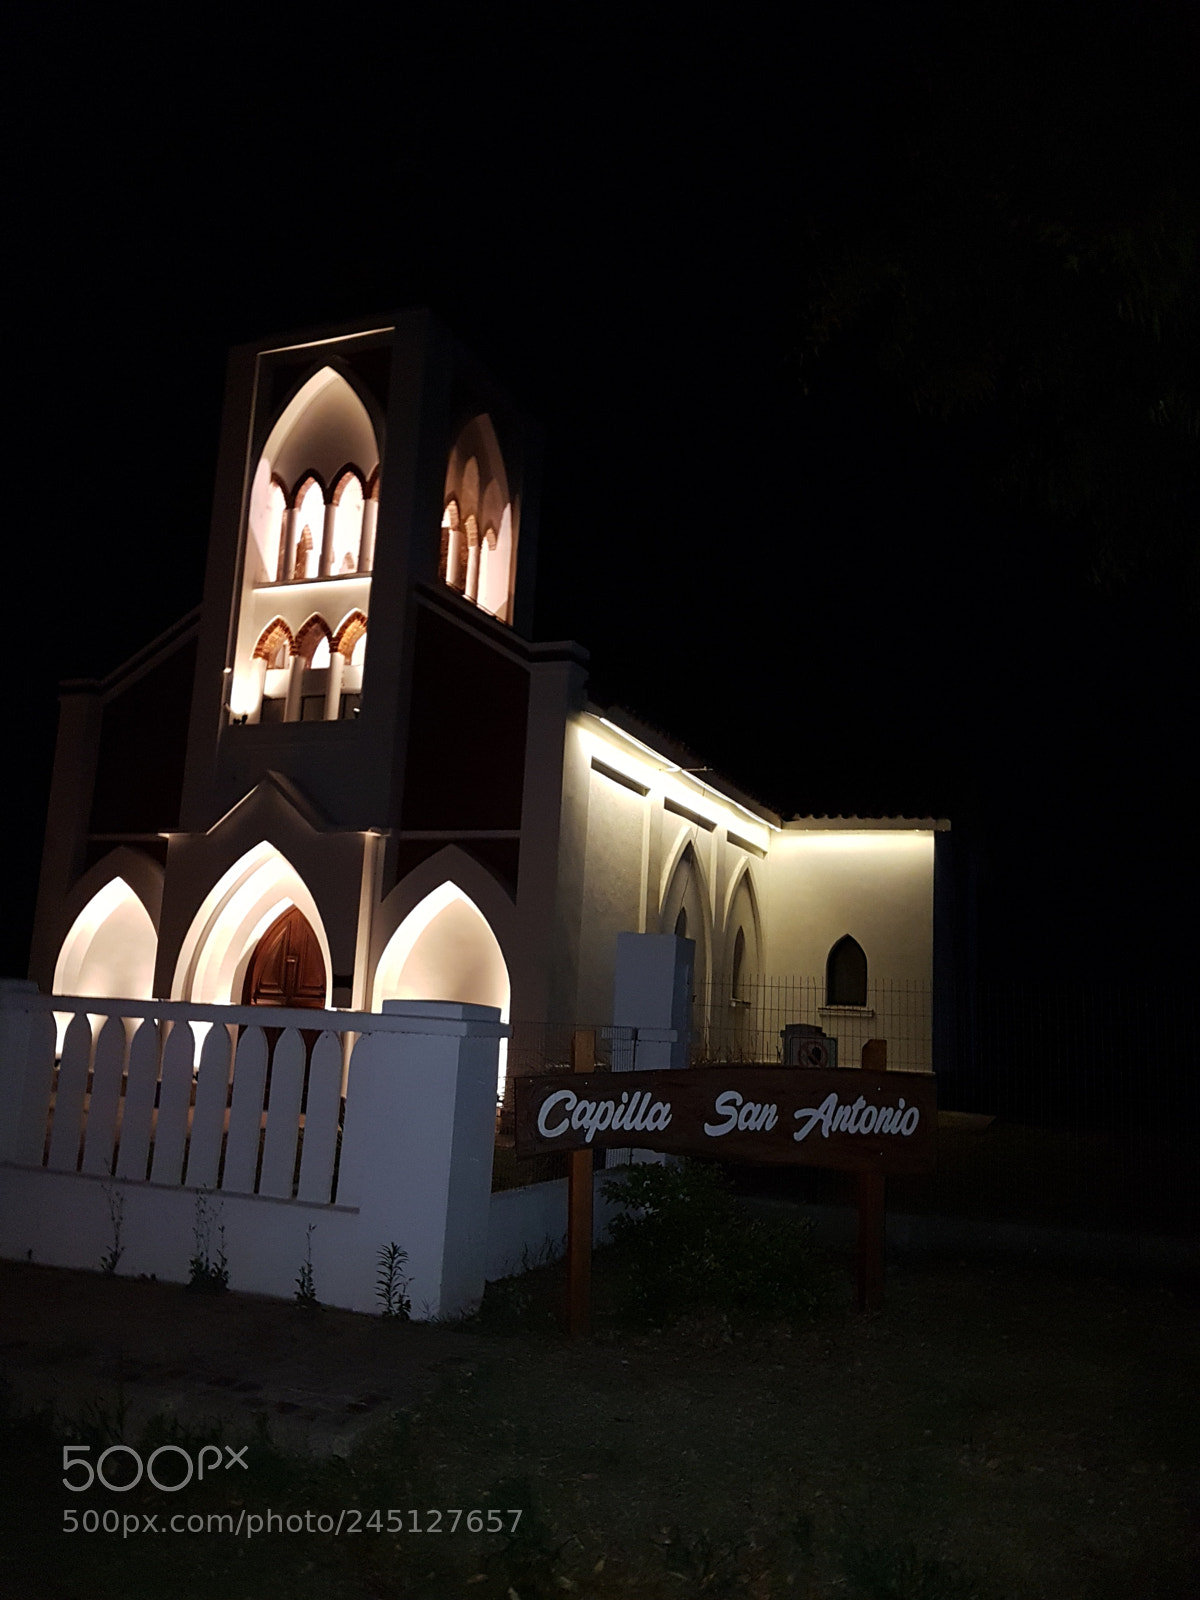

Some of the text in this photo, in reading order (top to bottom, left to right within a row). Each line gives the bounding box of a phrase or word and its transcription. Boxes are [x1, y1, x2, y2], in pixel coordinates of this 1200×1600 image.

[537, 1089, 920, 1143] Capilla San Antonio
